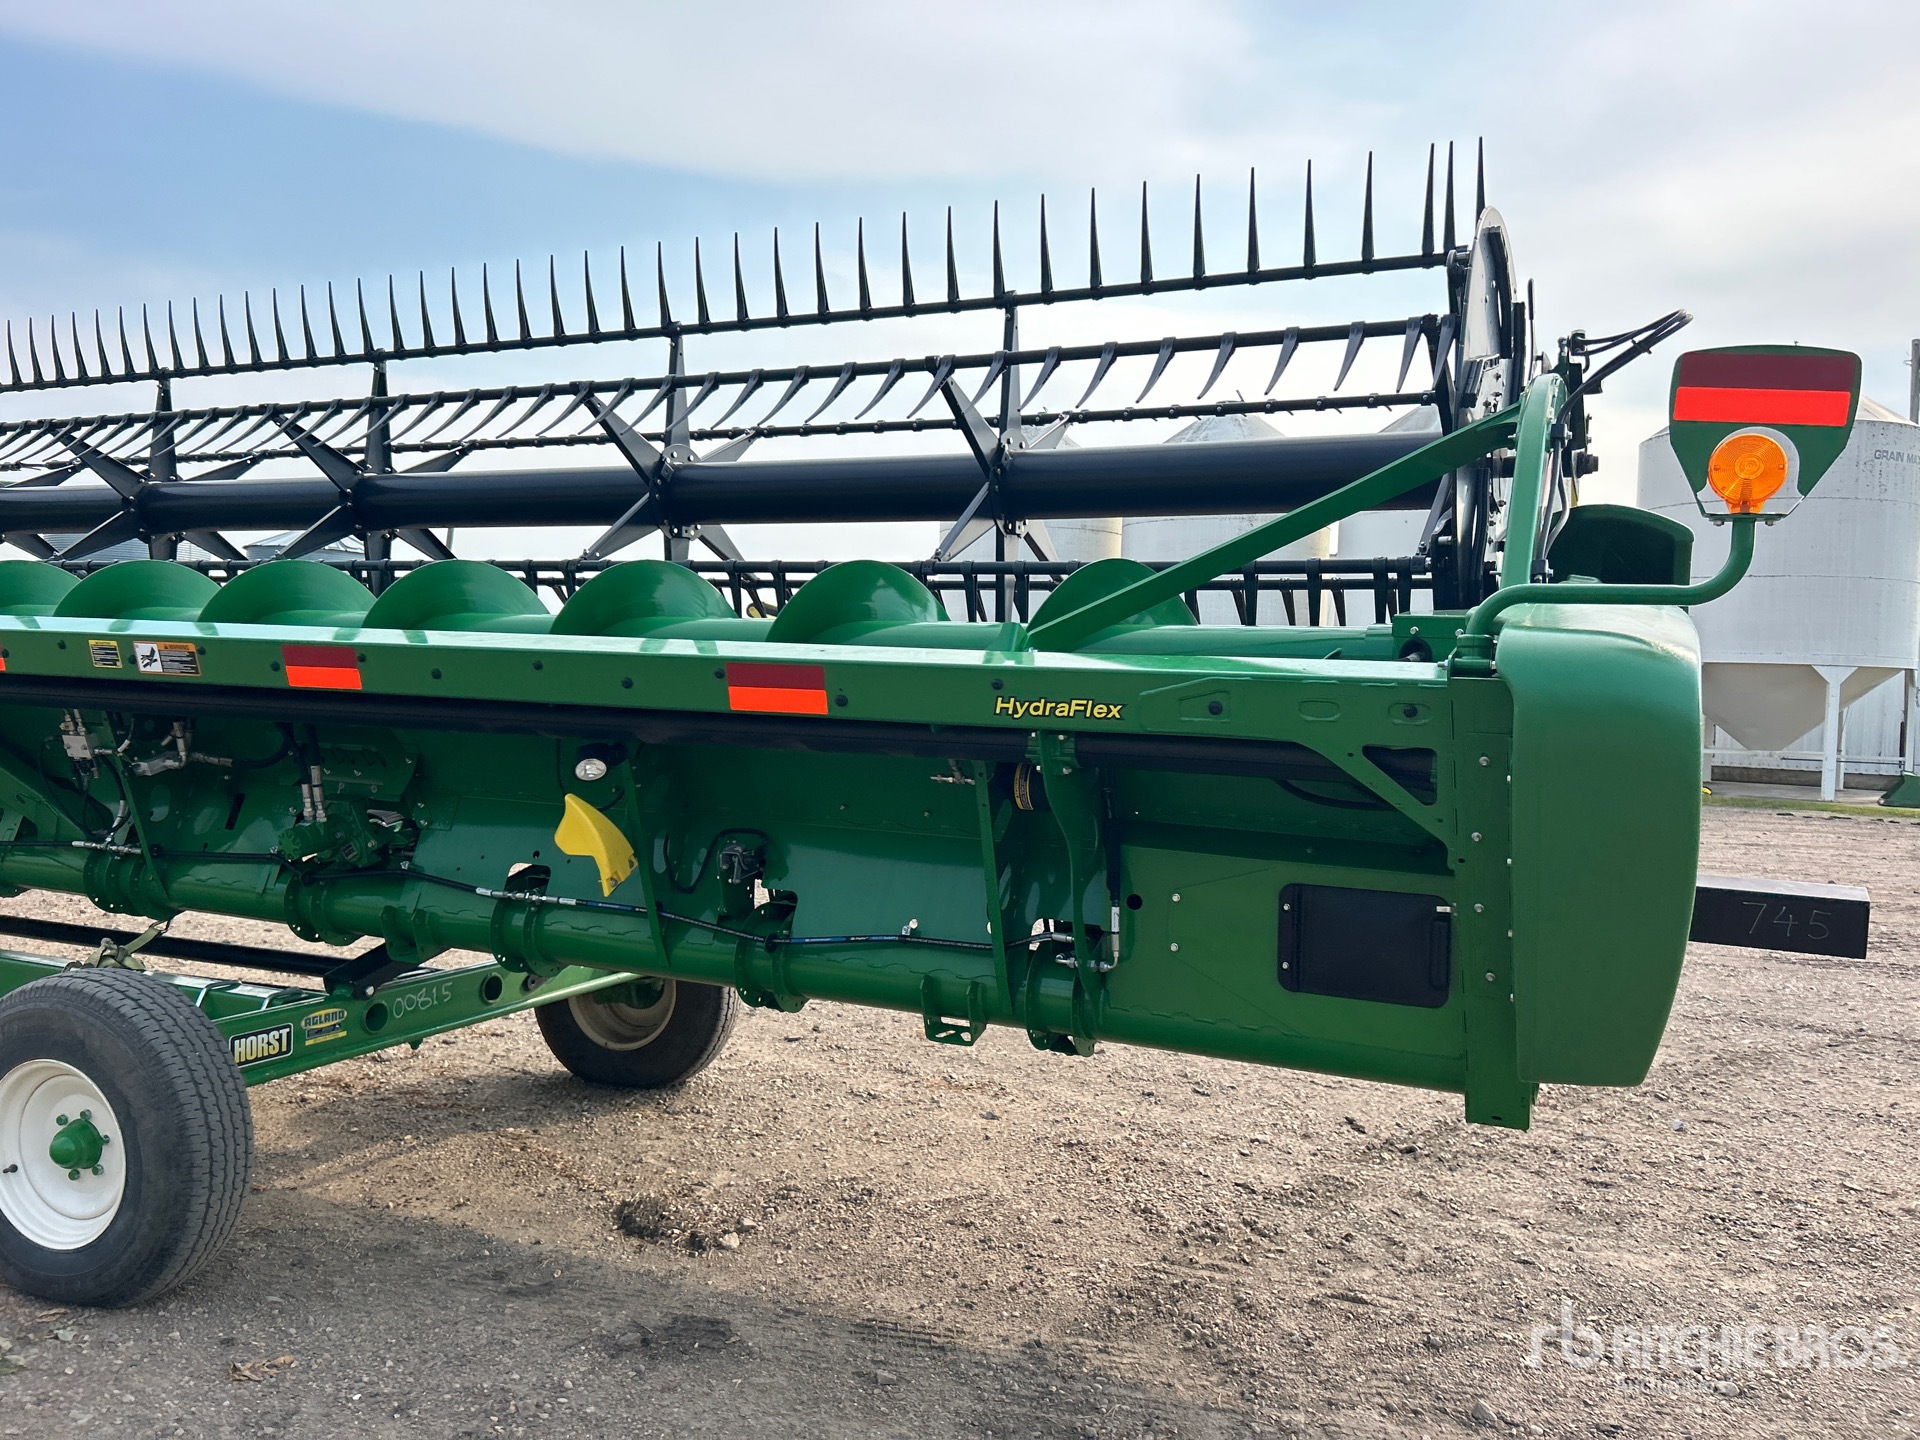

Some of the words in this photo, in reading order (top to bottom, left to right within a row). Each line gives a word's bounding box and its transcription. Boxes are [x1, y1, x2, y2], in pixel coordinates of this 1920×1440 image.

[1874, 449, 1905, 463] GRAIN
[995, 696, 1123, 719] HydraFlex
[1742, 900, 1832, 940] 745
[393, 981, 453, 1019] 00815
[304, 1010, 345, 1027] AGLAND
[234, 1027, 290, 1064] HORST
